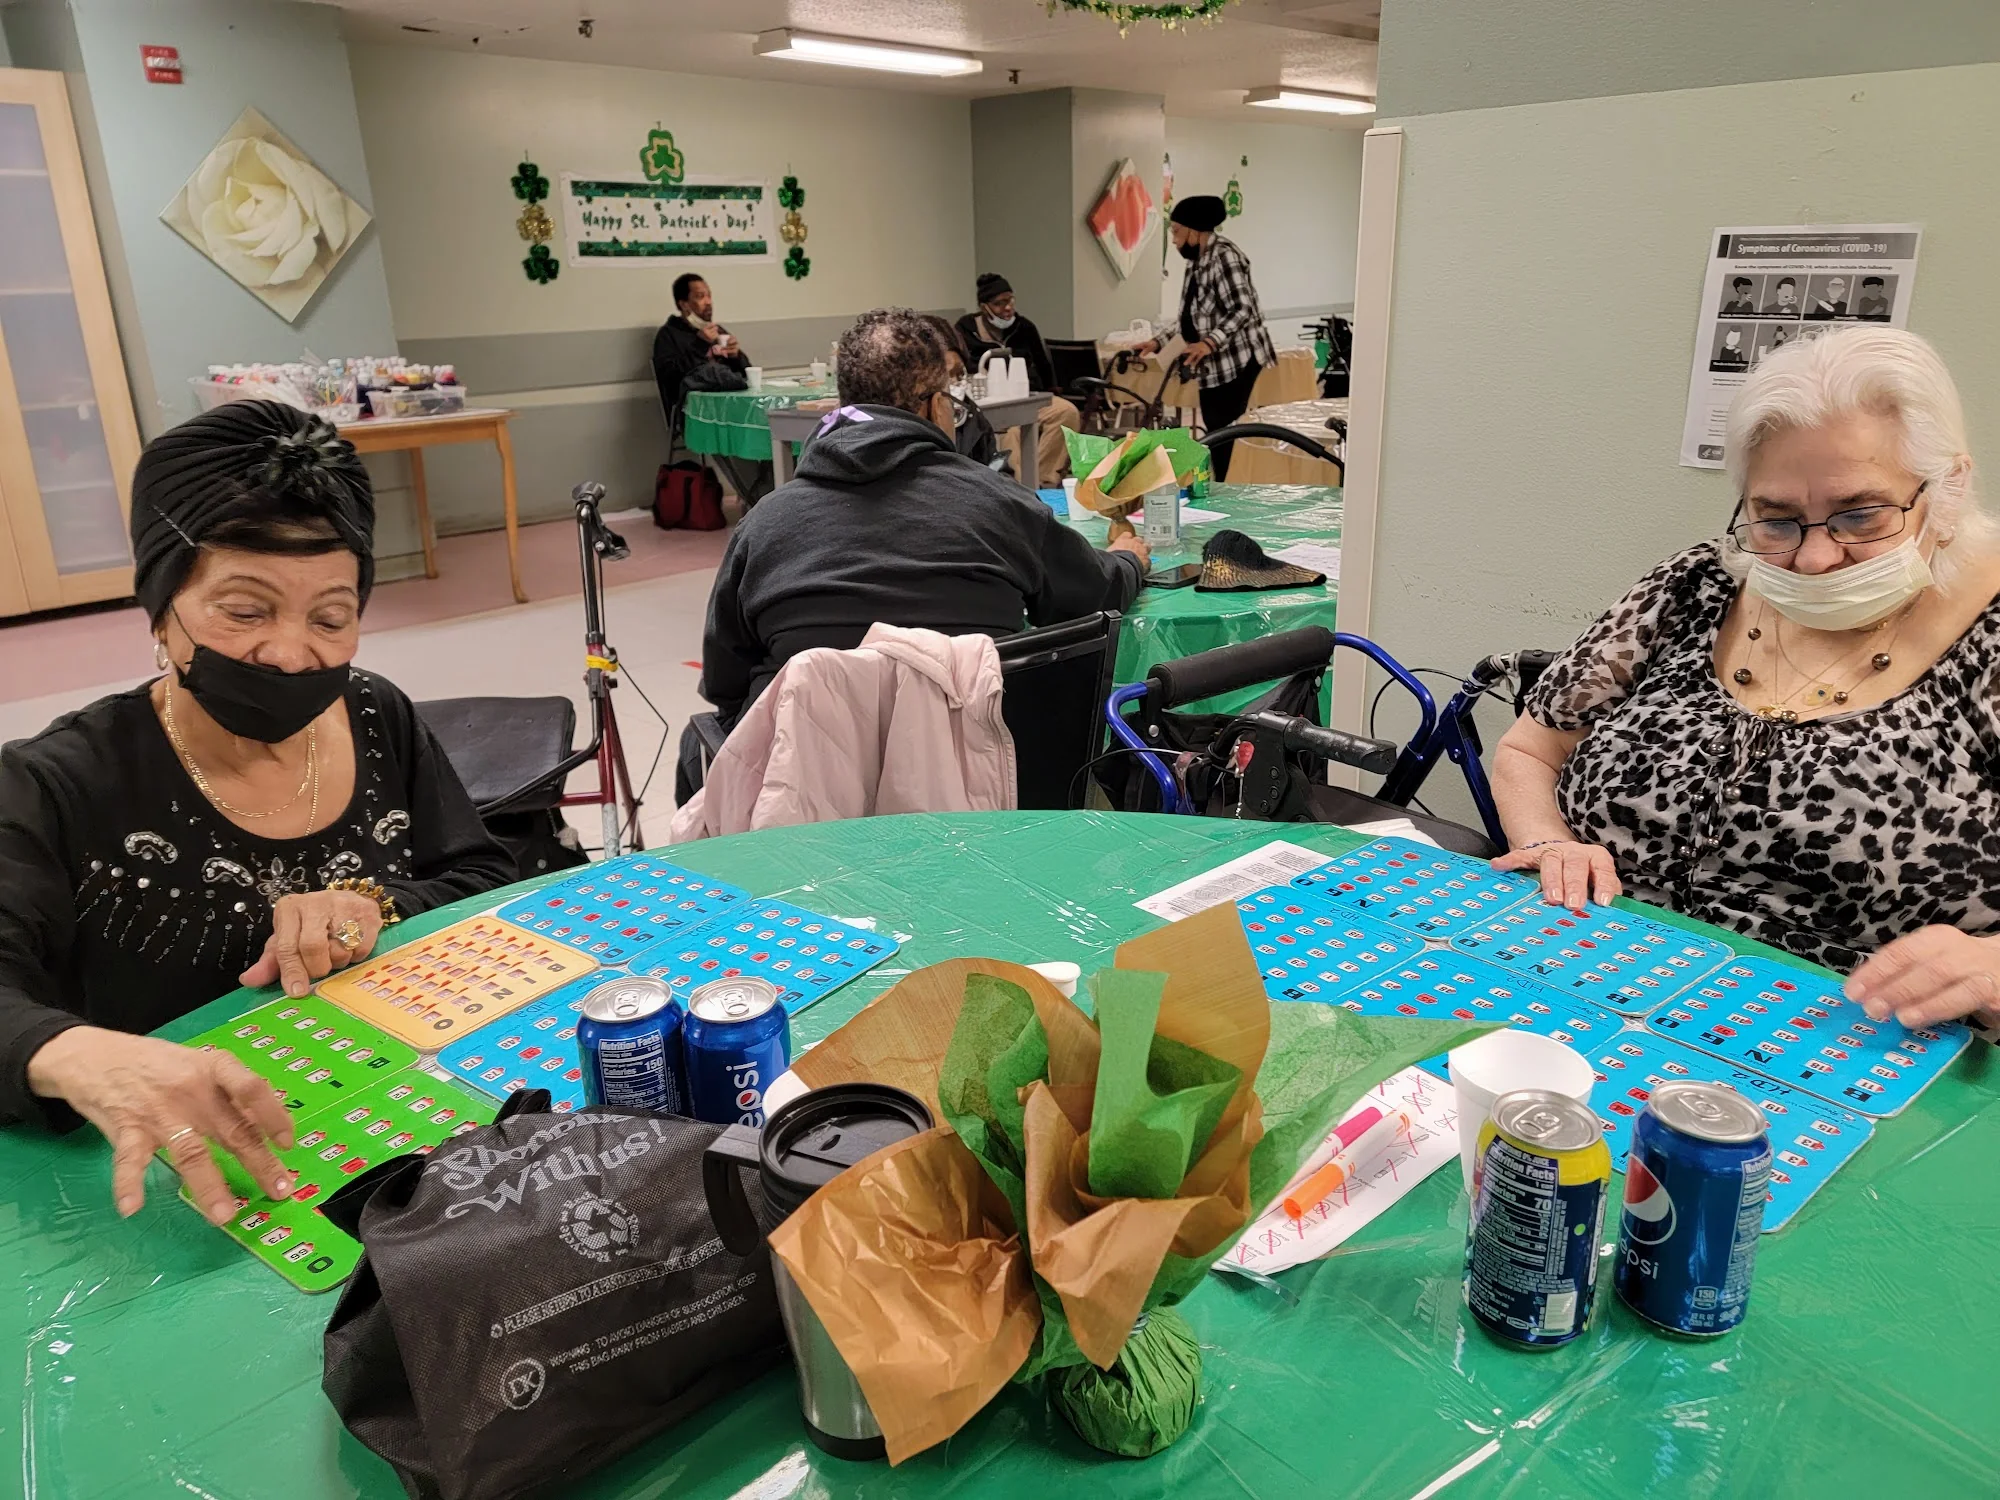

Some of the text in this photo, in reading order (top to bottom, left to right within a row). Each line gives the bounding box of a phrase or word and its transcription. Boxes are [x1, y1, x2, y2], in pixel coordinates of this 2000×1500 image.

[583, 211, 755, 230] Happy St. Patrick's Day!
[1738, 243, 1888, 255] Symptoms of Coronavirus (COVID-19)
[1295, 879, 1314, 887] O
[1324, 888, 1344, 896] G
[1352, 898, 1374, 908] N
[1415, 922, 1437, 931] B
[1458, 938, 1480, 948] O
[863, 945, 884, 955] B
[1492, 950, 1516, 961] G
[546, 963, 566, 972] B
[1527, 964, 1553, 975] N
[809, 974, 833, 986] N
[490, 988, 515, 1000] N
[781, 991, 804, 1003] G
[1282, 988, 1305, 1000] B
[1605, 993, 1631, 1005] B
[463, 1003, 484, 1014] G
[433, 1018, 454, 1031] O
[644, 1057, 664, 1071] 150
[1654, 1017, 1873, 1102] B I N G O
[328, 1056, 391, 1089] B I
[726, 1060, 763, 1130] epsi
[444, 1119, 668, 1219] With us!
[1525, 1164, 1555, 1181] Facts
[1534, 1197, 1552, 1211] 70
[306, 1255, 334, 1274] O
[1619, 1237, 1660, 1280] epsi
[595, 1335, 609, 1349] TO
[609, 1324, 635, 1344] AVOID
[670, 1307, 682, 1319] OF
[590, 1351, 611, 1367] BAG
[610, 1341, 634, 1359] AWAY
[635, 1331, 660, 1349] FROM
[690, 1310, 707, 1327] AND
